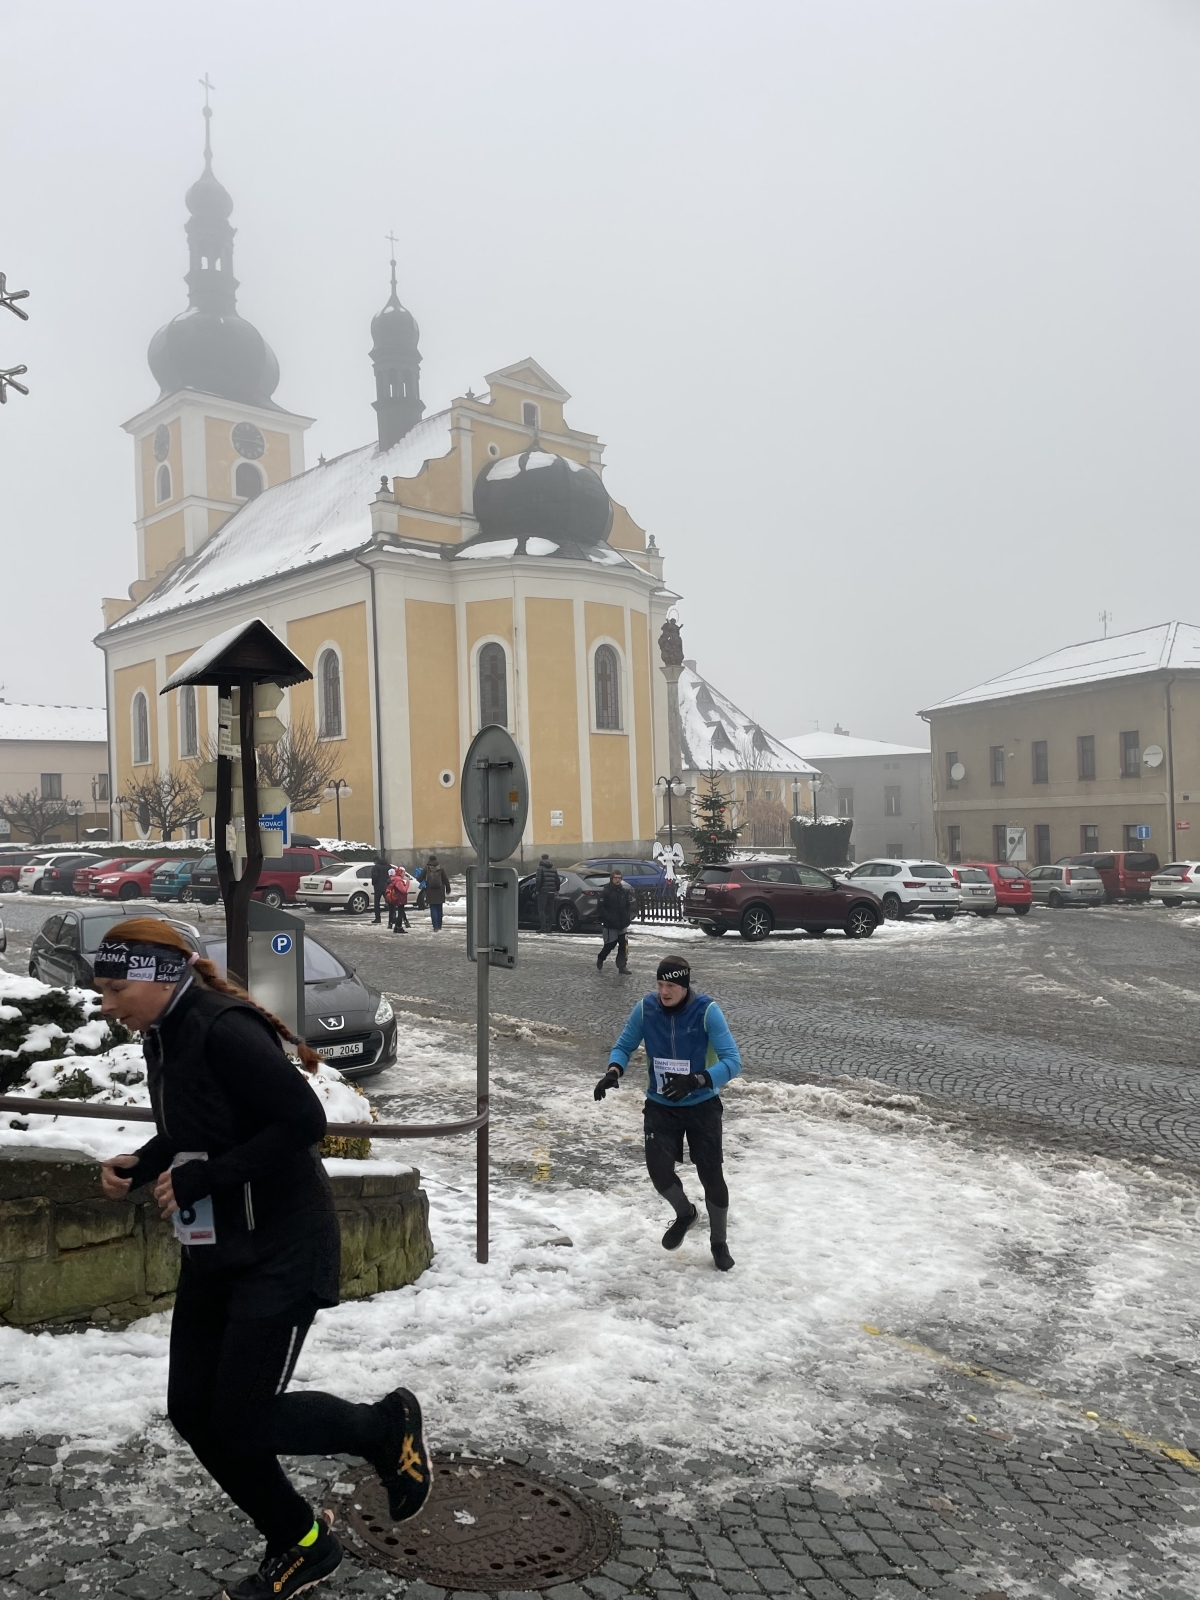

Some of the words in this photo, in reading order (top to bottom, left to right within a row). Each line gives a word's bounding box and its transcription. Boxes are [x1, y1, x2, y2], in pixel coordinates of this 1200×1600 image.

[277, 937, 288, 951] P
[128, 955, 157, 969] SVÁ
[129, 971, 153, 979] bojuj
[340, 1043, 360, 1056] 2045
